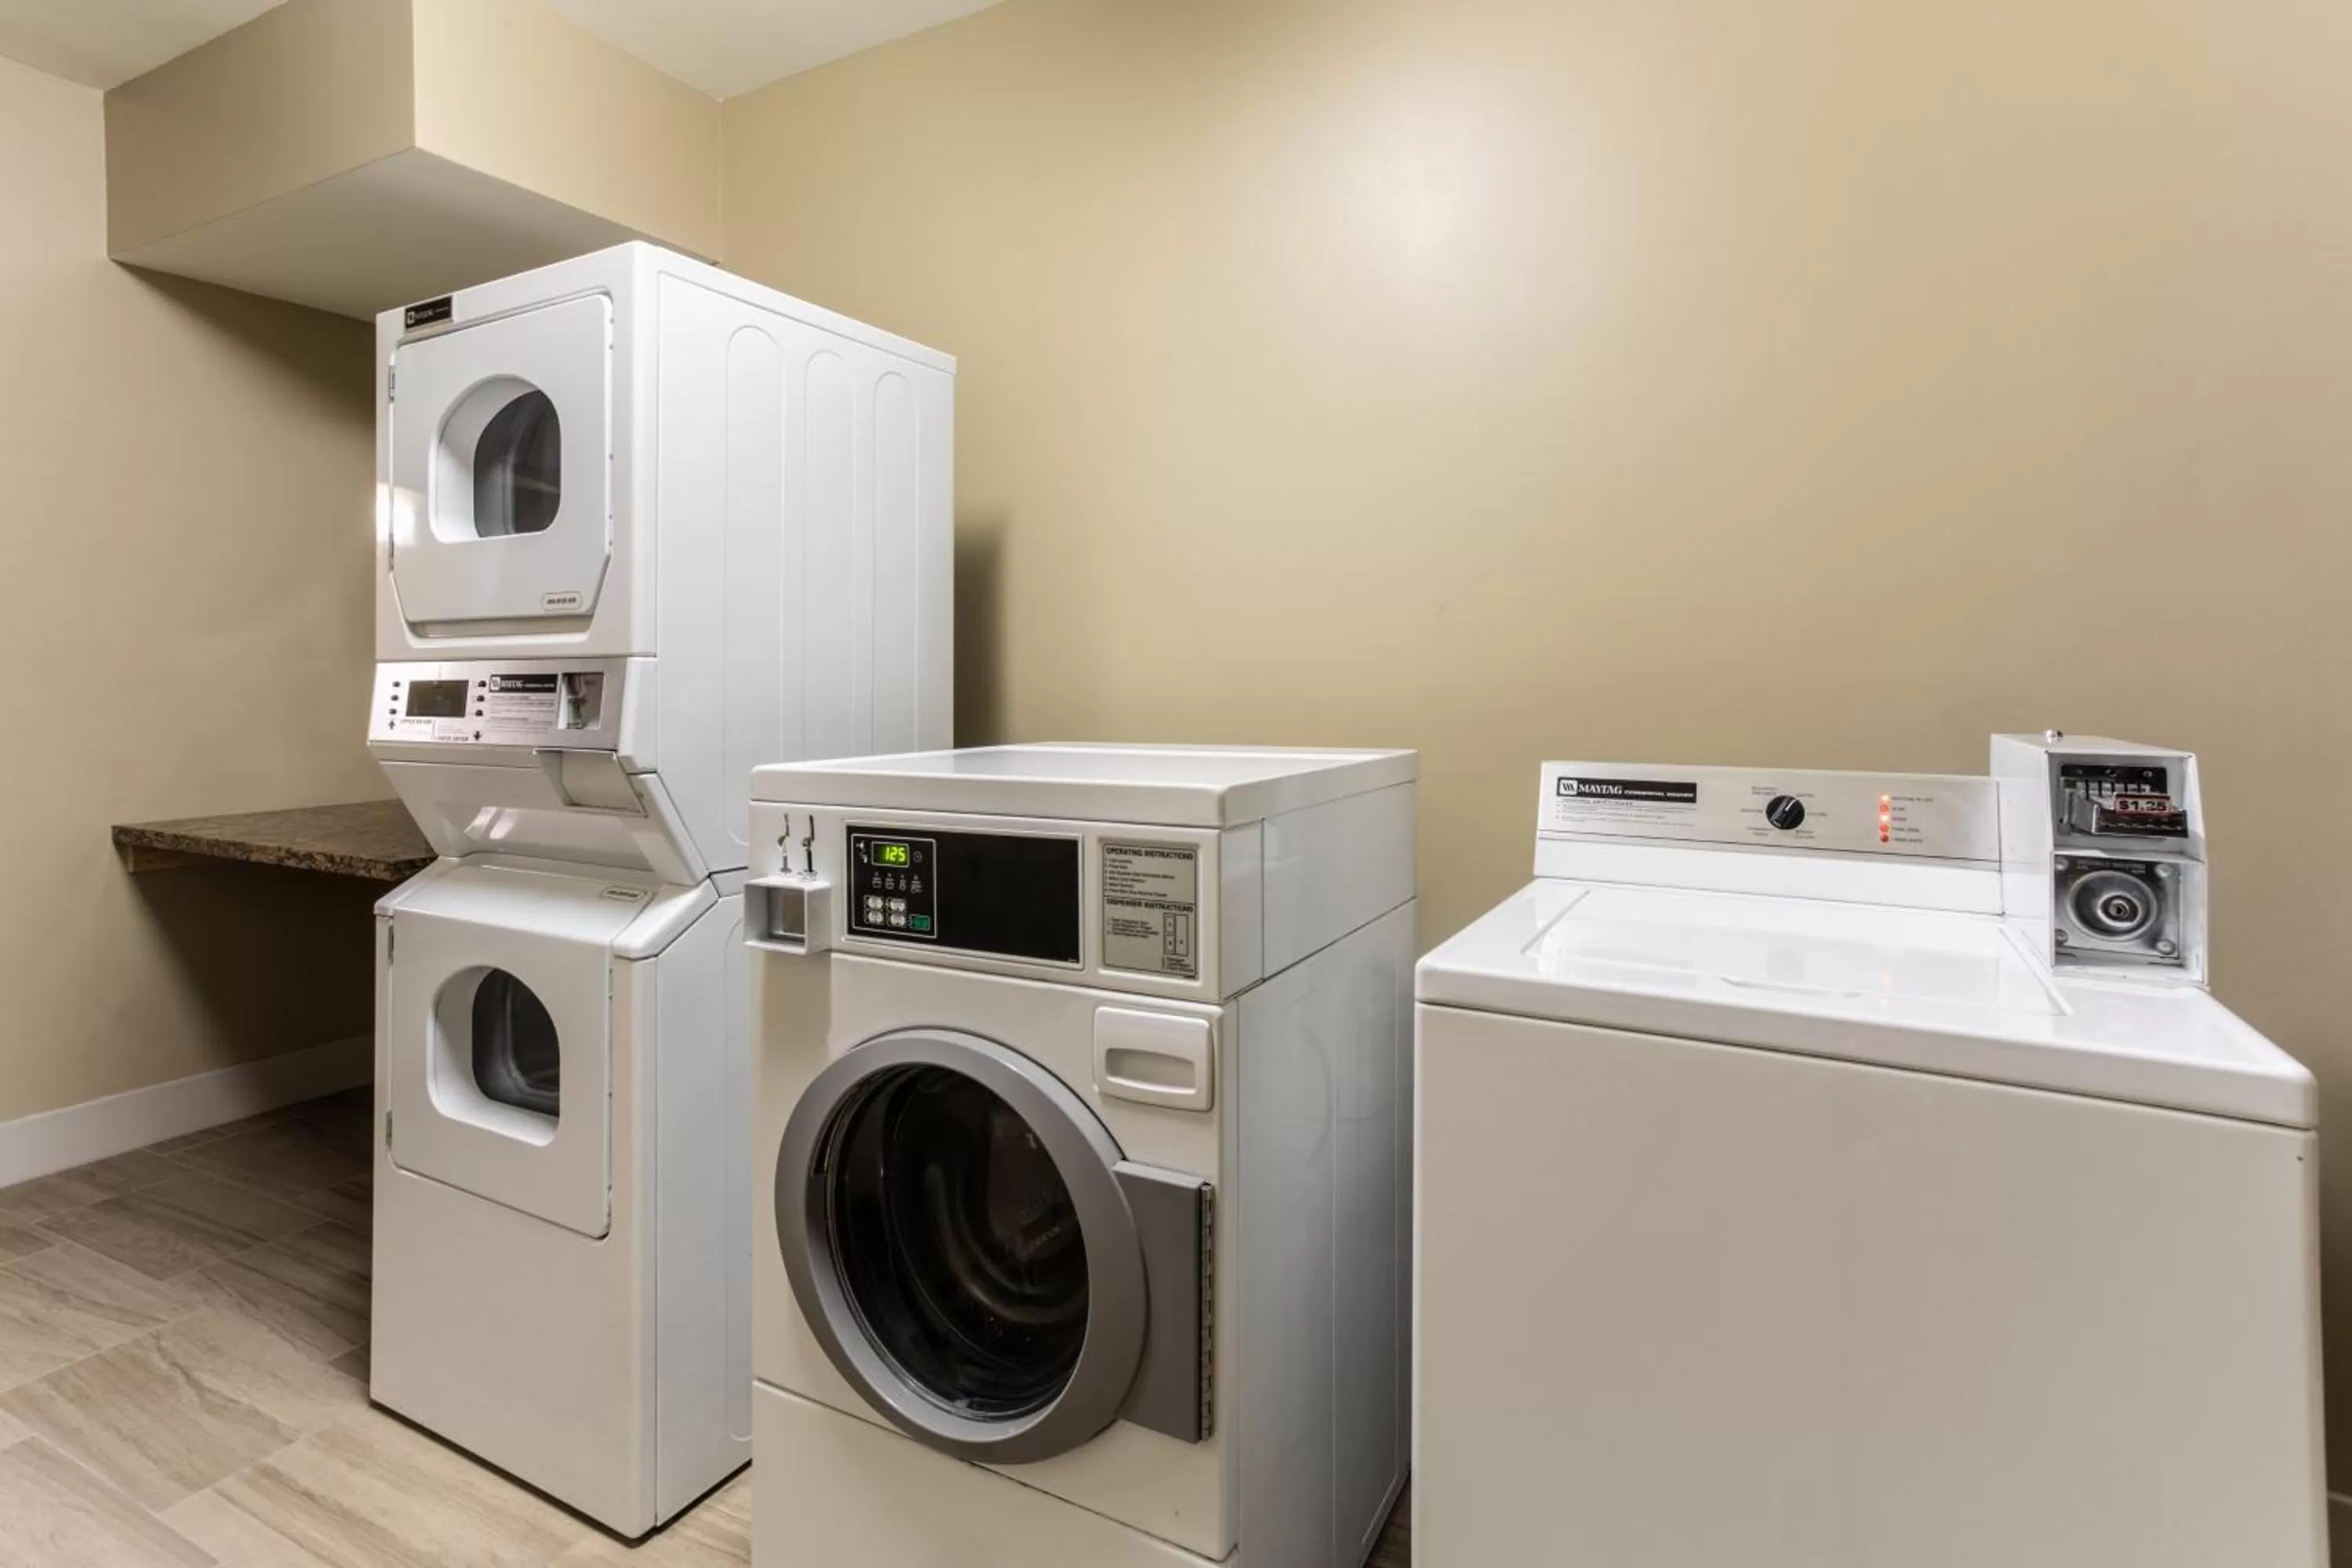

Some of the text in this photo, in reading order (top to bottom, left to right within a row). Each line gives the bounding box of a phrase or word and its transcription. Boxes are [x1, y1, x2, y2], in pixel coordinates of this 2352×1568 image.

[1578, 784, 1623, 795] MAYTAG
[2118, 800, 2167, 812] $1.25
[885, 846, 906, 862] 125
